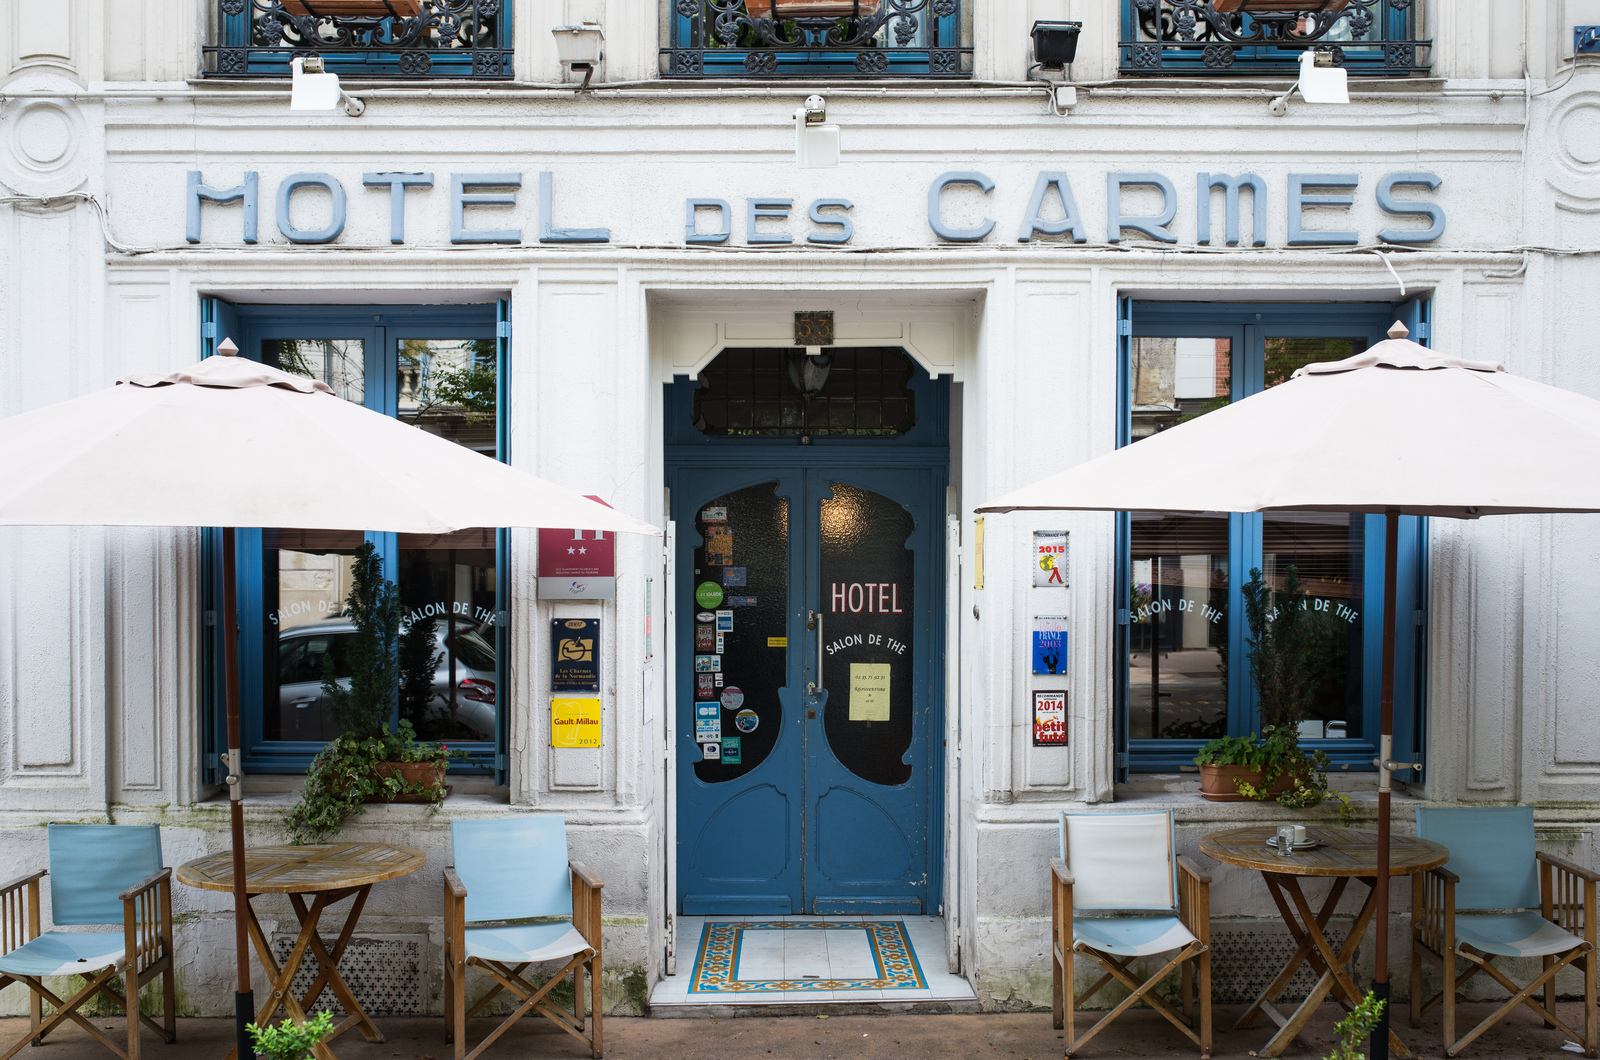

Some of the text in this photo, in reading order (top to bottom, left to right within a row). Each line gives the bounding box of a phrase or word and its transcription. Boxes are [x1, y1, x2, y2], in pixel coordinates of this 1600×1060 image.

[185, 169, 1446, 245] HOTEL DES CARMES
[832, 583, 903, 613] HOTEL
[269, 600, 311, 625] SALON
[318, 600, 336, 614] DE
[403, 601, 496, 626] SALON DE THE
[1130, 599, 1223, 624] SALON DE THE
[1314, 599, 1331, 612] DE
[1335, 603, 1359, 624] THE
[826, 633, 907, 655] SALON DE THE
[1037, 701, 1064, 711] 2014
[1033, 721, 1067, 734] petit
